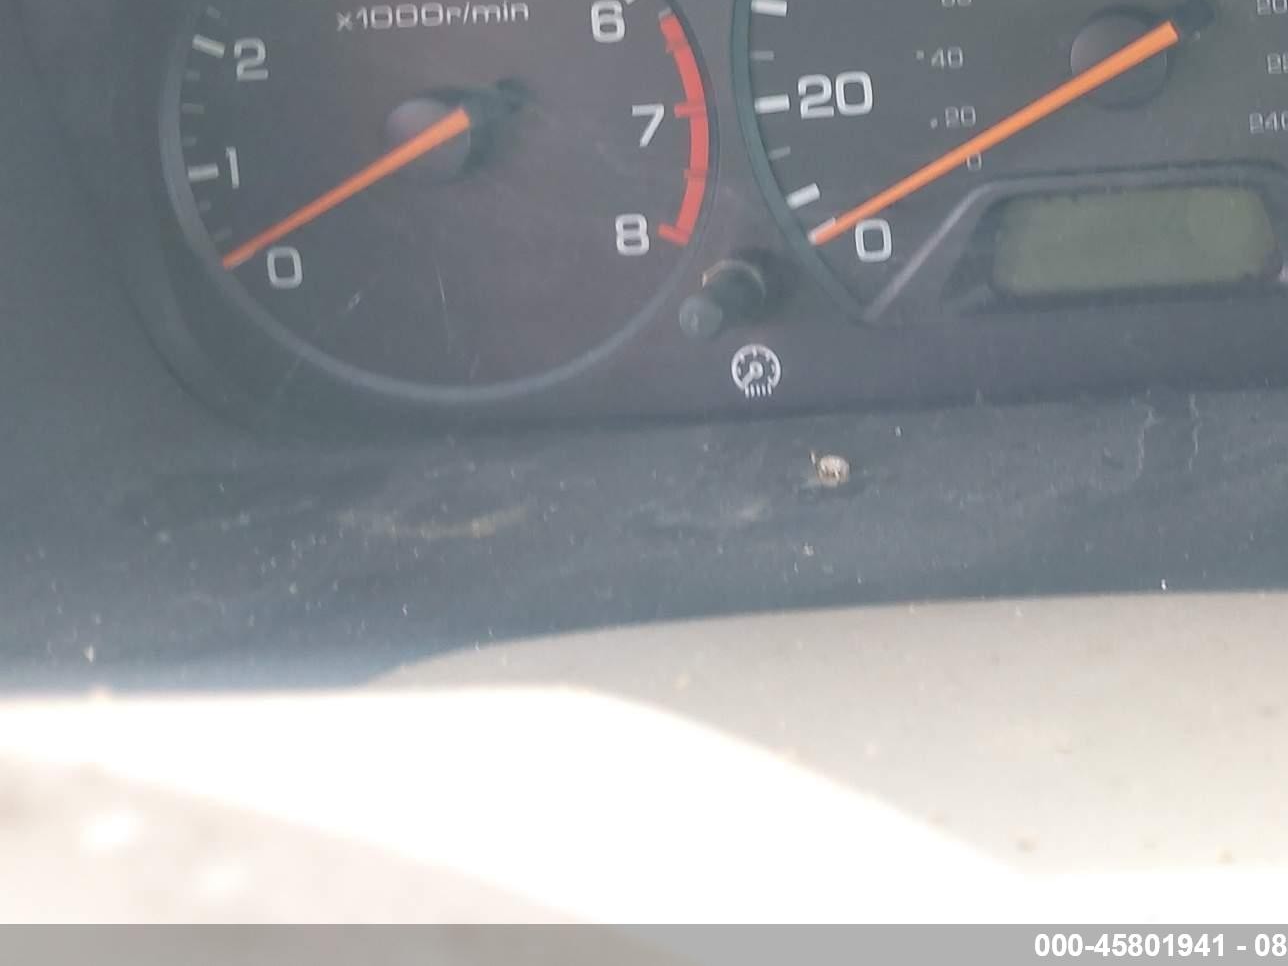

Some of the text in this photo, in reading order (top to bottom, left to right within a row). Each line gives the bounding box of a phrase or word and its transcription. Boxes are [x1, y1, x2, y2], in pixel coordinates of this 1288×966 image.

[336, 0, 529, 31] x1000r/min
[591, 0, 626, 42] 6
[234, 39, 268, 80] 2
[932, 48, 963, 67] 40
[798, 72, 872, 118] 20
[632, 104, 664, 146] 7
[945, 107, 976, 127] 20
[226, 147, 239, 188] 1
[616, 214, 649, 255] 8
[855, 220, 892, 262] 0
[267, 248, 302, 287] 0
